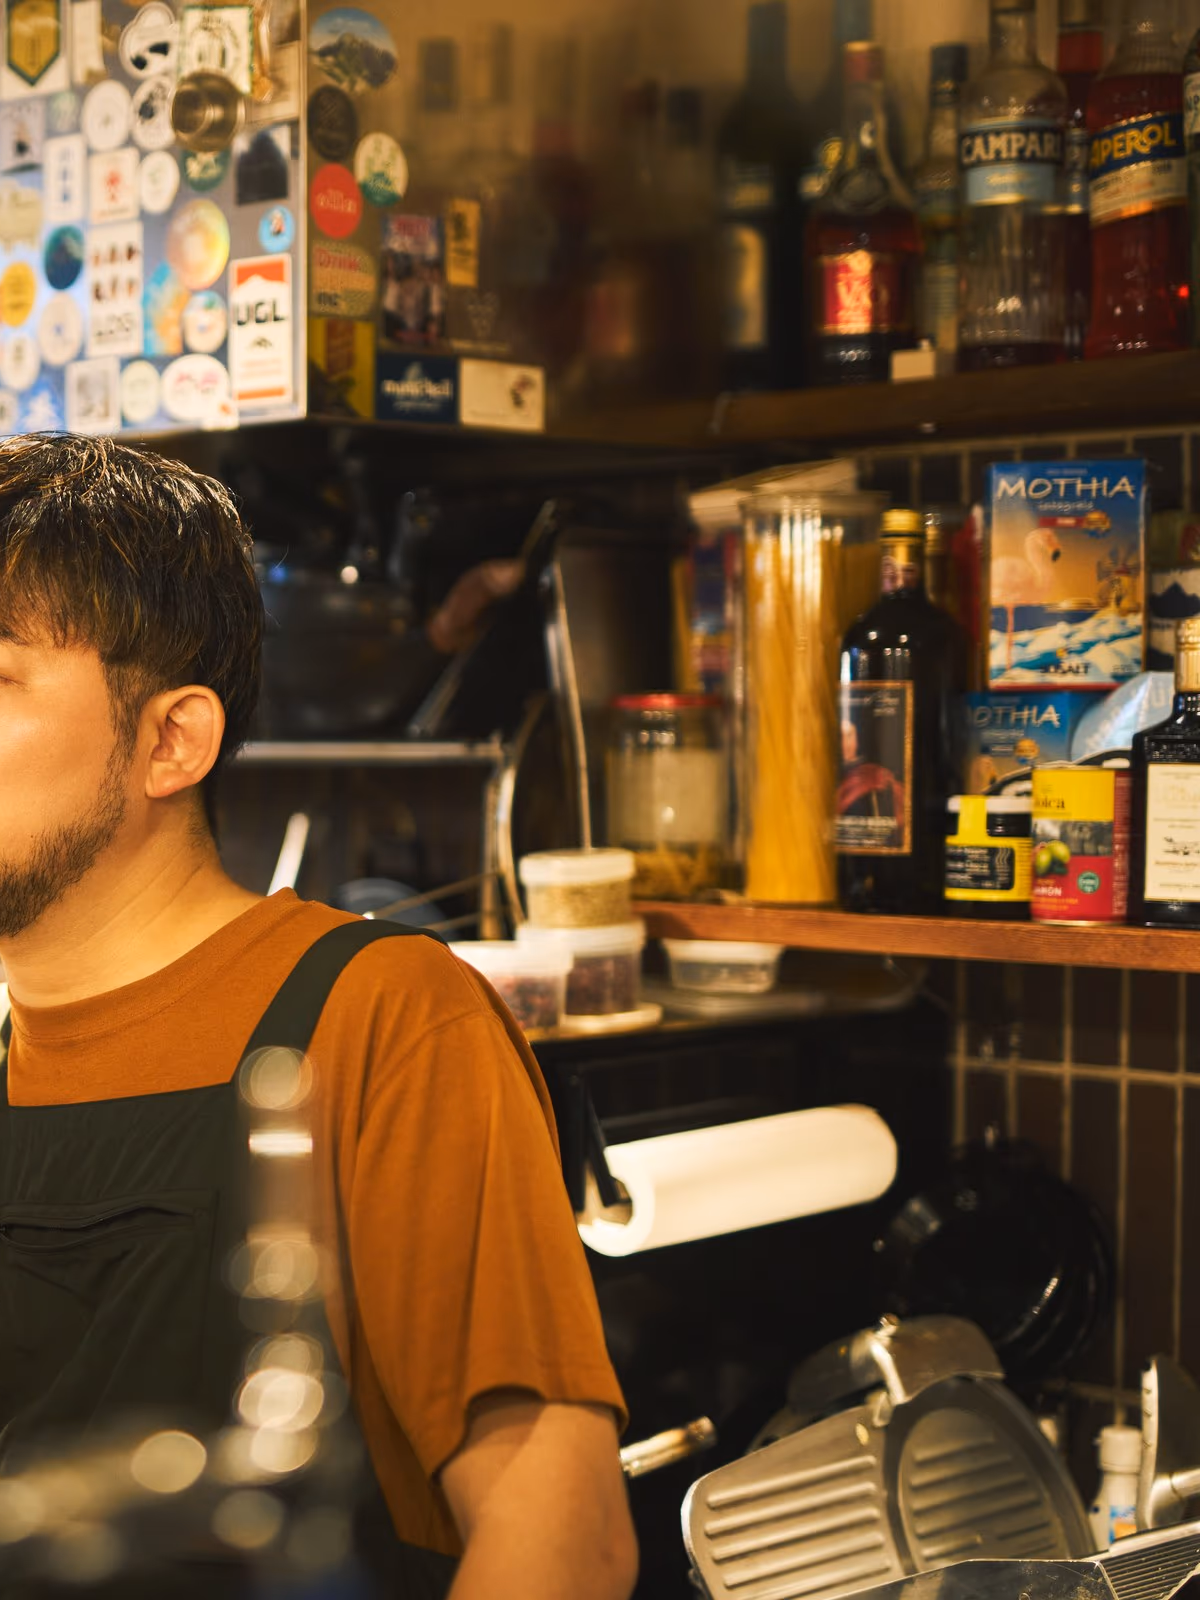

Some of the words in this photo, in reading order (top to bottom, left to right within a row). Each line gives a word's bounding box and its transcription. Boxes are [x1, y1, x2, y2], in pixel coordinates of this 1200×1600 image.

[1091, 121, 1177, 168] APEROL
[996, 475, 1136, 500] MOTHIA
[969, 704, 1061, 729] OTHIA
